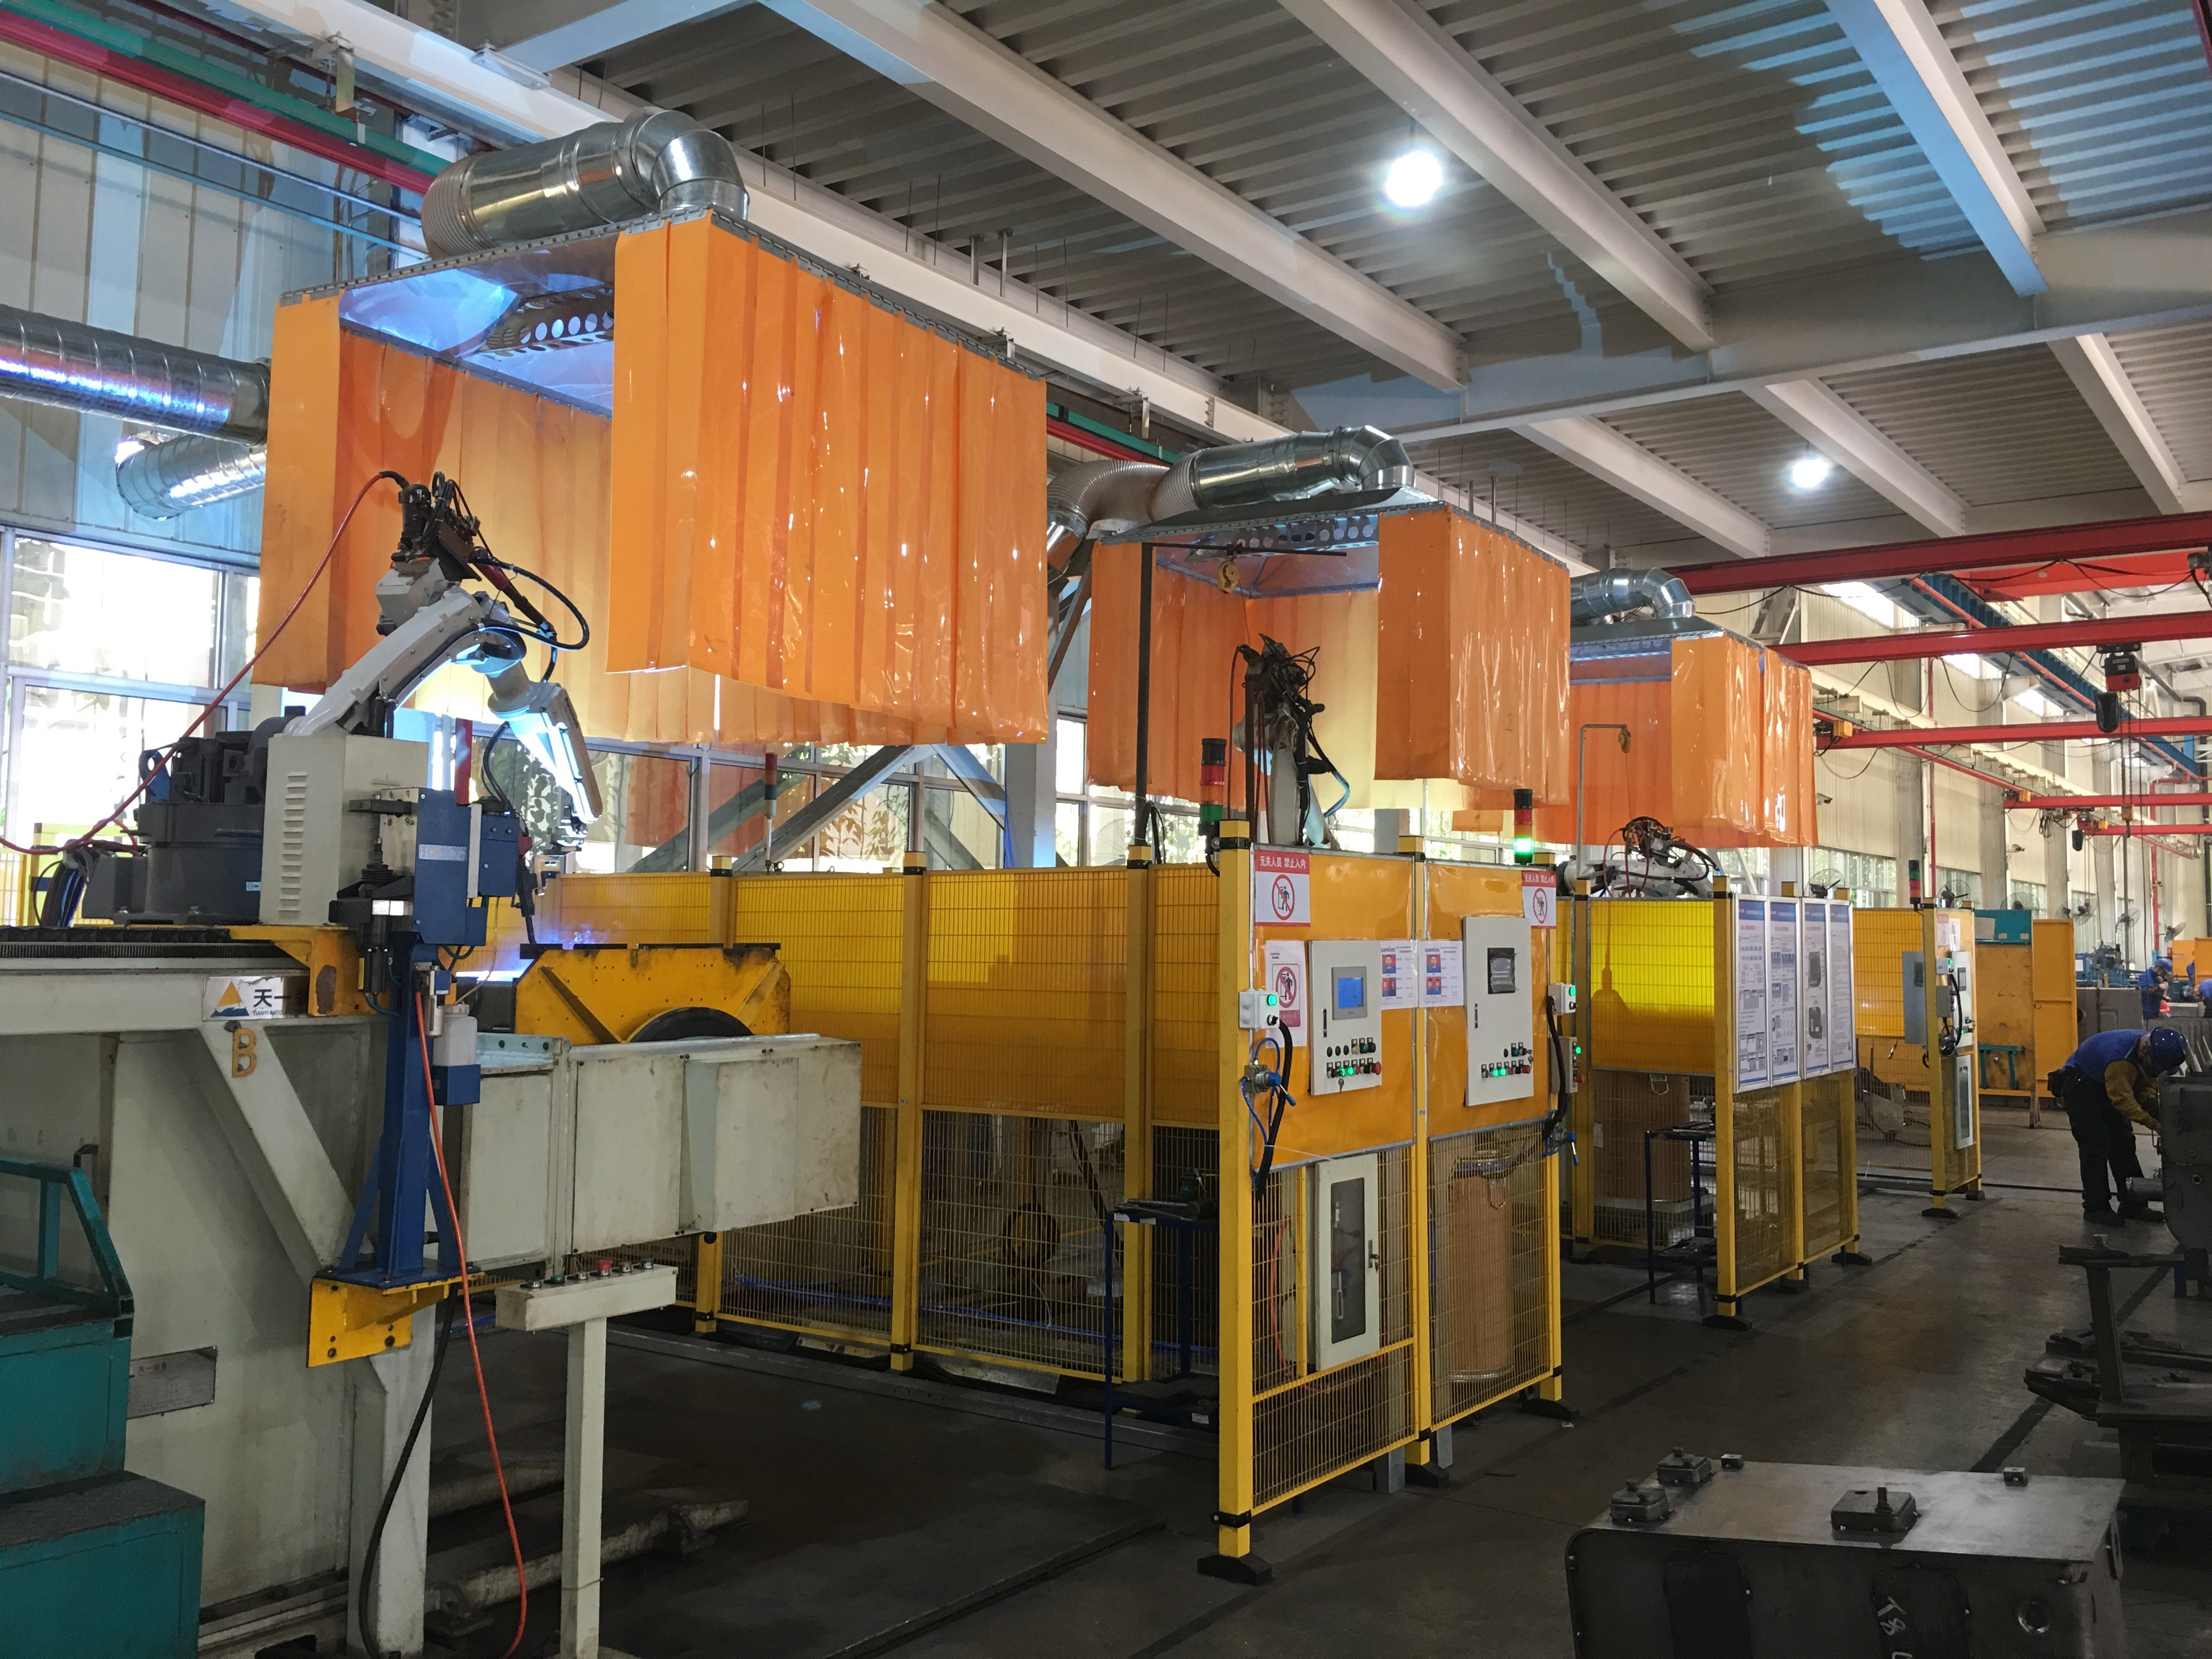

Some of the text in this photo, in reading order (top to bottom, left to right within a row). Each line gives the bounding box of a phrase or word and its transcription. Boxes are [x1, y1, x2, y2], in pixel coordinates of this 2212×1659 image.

[1260, 855, 1306, 869] 无关人员 禁止入内
[232, 1027, 257, 1078] B
